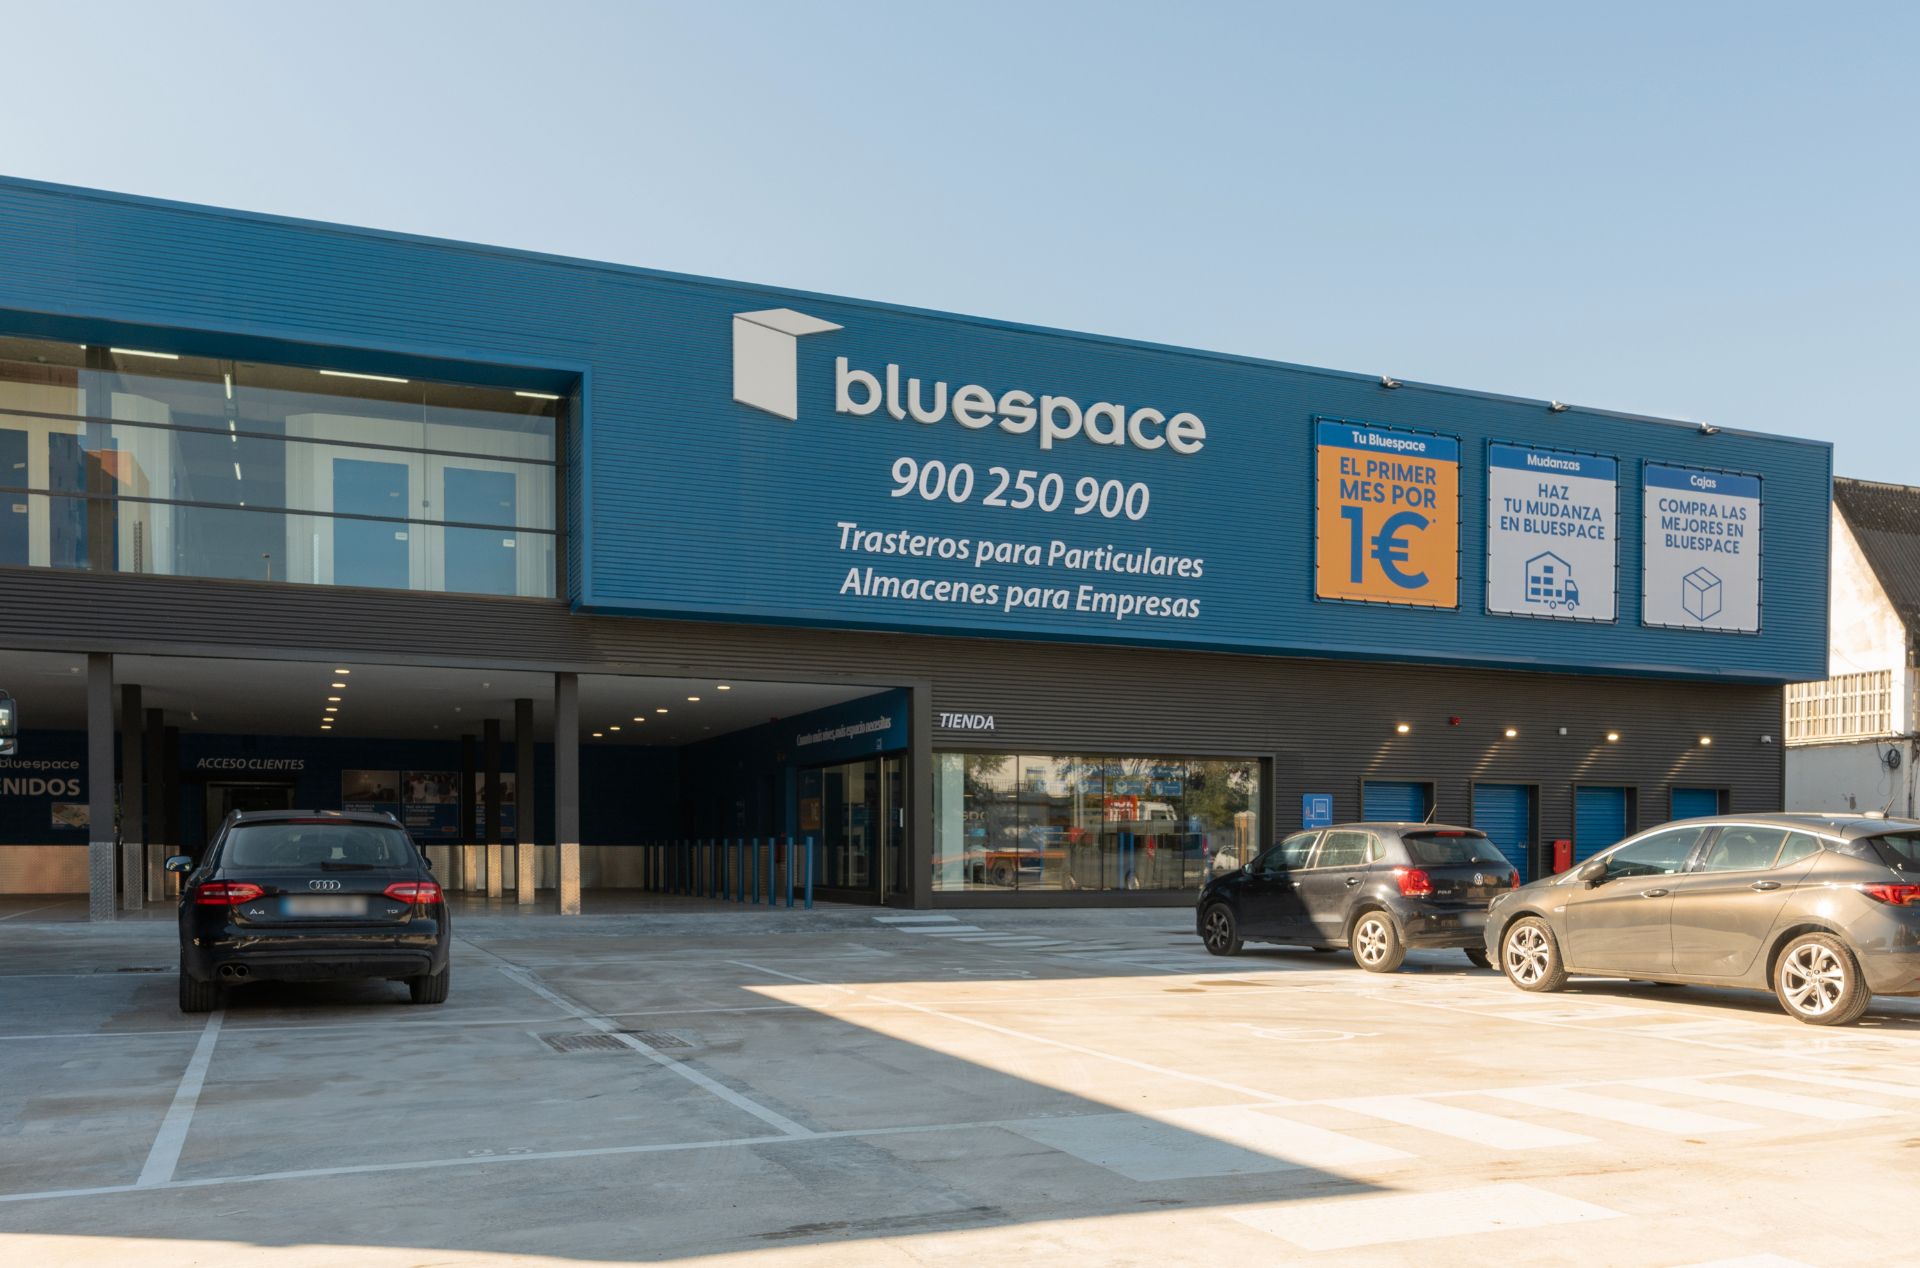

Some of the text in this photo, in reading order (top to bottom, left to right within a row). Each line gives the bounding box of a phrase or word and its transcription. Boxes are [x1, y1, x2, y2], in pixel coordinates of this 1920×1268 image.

[835, 356, 1206, 454] bluespace
[1352, 431, 1426, 452] Tu Bluespace
[1340, 456, 1437, 485] EL PRIMER
[1527, 454, 1580, 471] Mudanzas
[891, 457, 1150, 520] 900 250 900
[1340, 478, 1437, 509] MES POR
[1538, 483, 1570, 500] HAZ
[1690, 475, 1717, 489] Cajas
[1503, 497, 1602, 522] TU MUDANZA
[1658, 498, 1747, 521] COMPRA LAS
[1500, 515, 1605, 540] EN BLUESPACE
[1661, 515, 1744, 538] MEJORES EN
[837, 522, 1204, 578] Trasteros para Particulares
[1665, 533, 1740, 554] BLUESPACE
[840, 568, 1201, 620] Almacenes para Empresas
[940, 713, 995, 730] TIENDA
[196, 758, 305, 770] ACCESO CLIENTES
[0, 777, 81, 796] NIDOS
